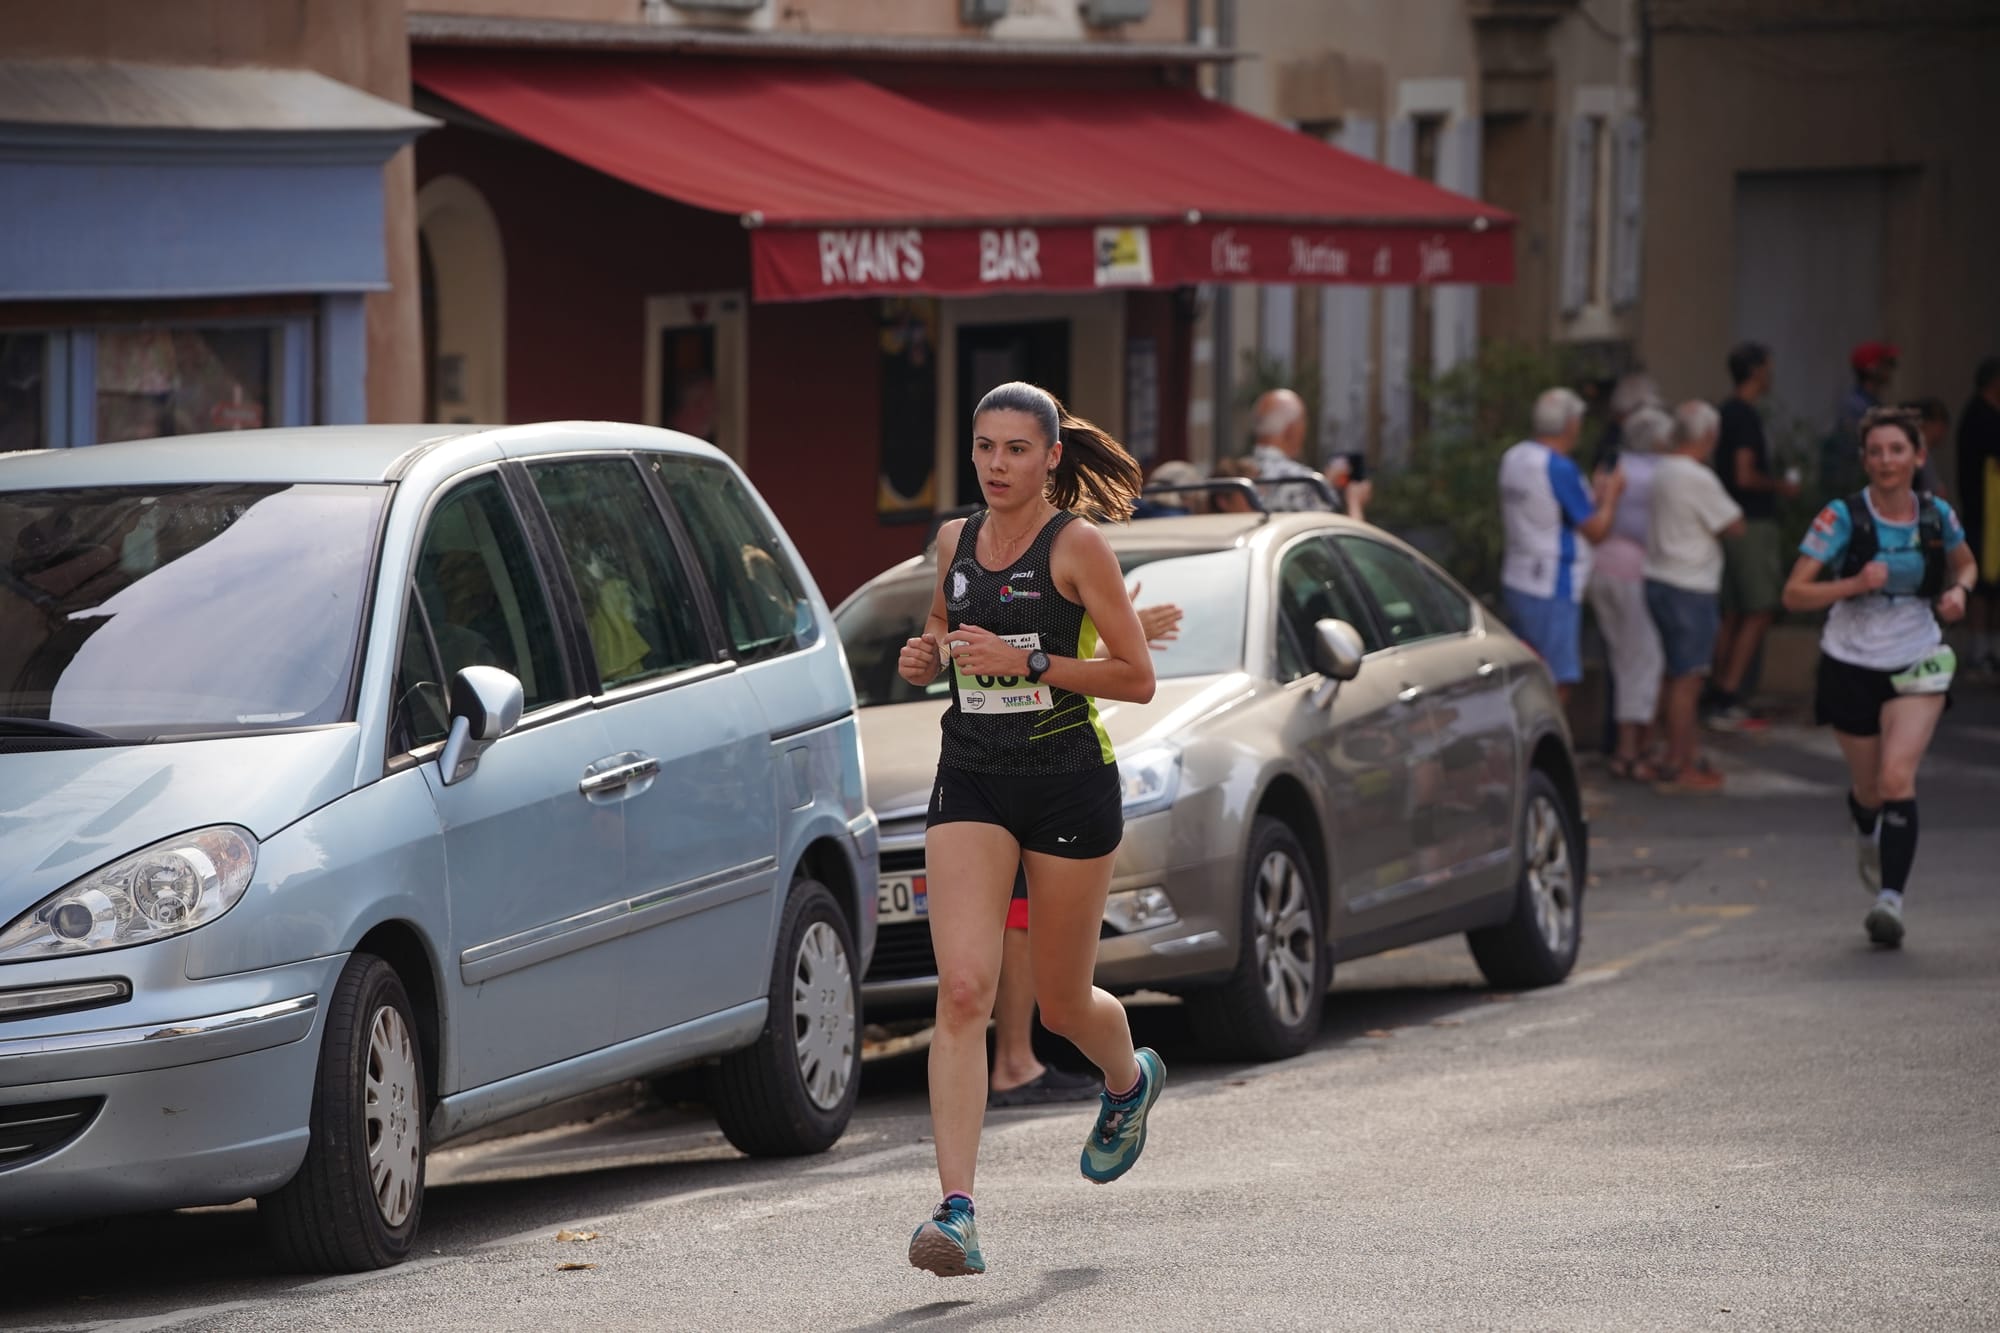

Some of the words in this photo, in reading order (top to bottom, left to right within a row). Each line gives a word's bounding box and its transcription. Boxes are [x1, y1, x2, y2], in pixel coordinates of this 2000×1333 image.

[819, 230, 924, 284] RYAN'S
[979, 229, 1042, 283] BAR
[1001, 694, 1032, 703] TUFF'S
